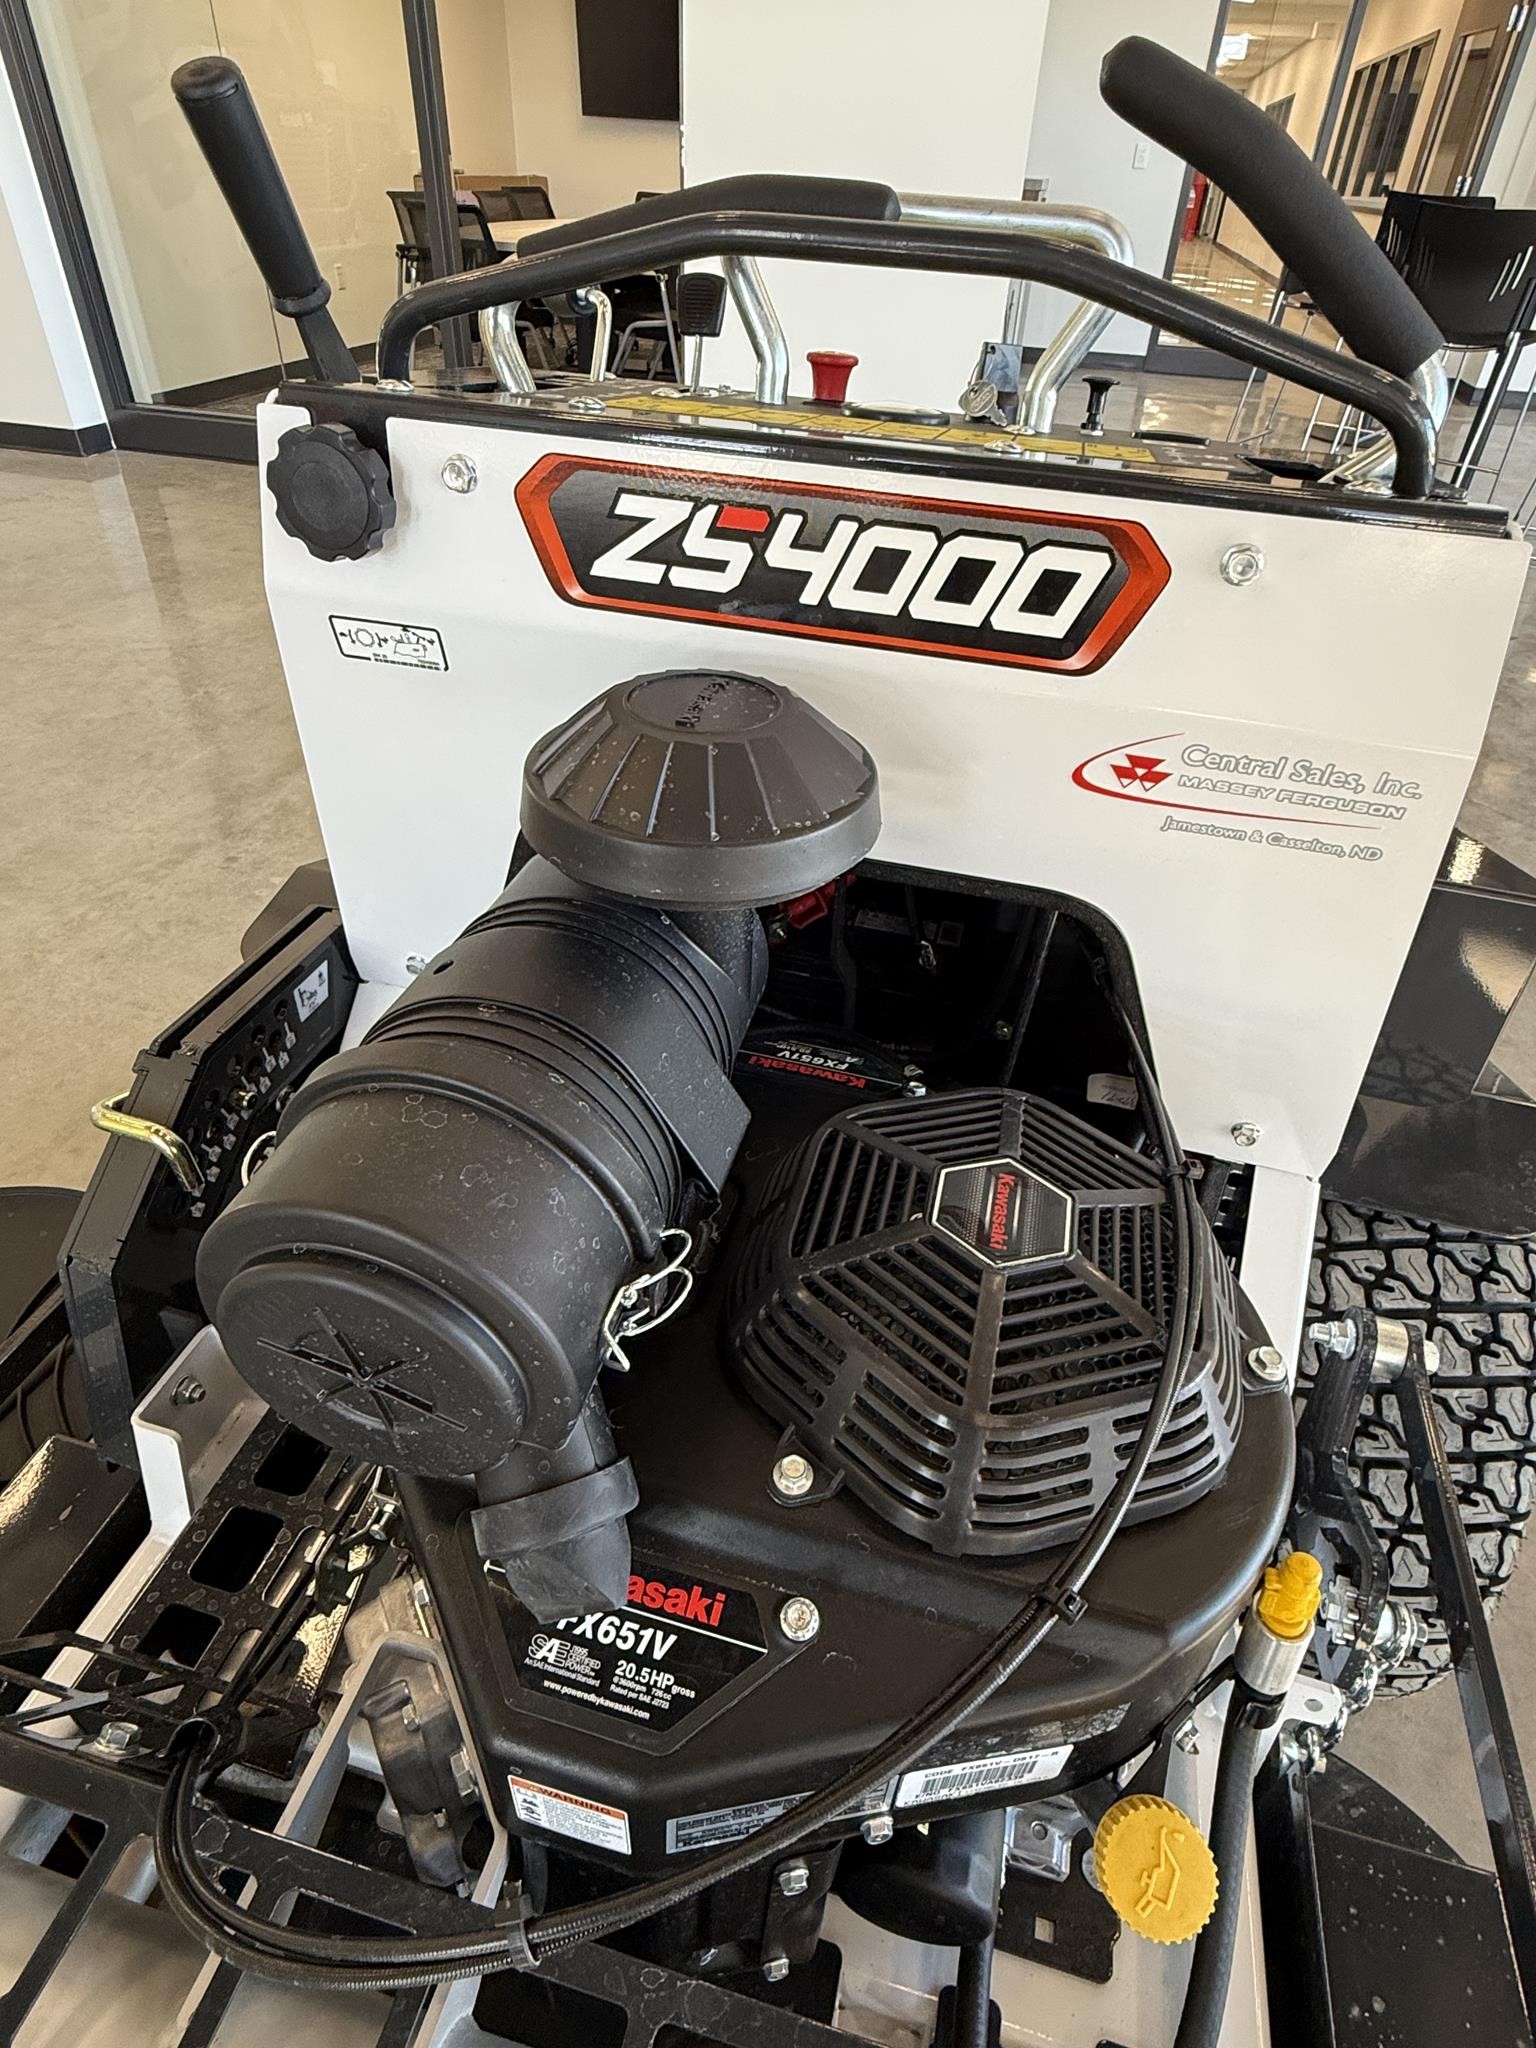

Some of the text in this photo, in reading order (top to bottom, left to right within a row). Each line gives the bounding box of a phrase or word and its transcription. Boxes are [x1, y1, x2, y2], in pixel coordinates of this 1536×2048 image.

[589, 493, 1112, 639] ZS4000
[1181, 744, 1423, 800] Central Sales, Inc.
[1178, 775, 1407, 820] MASSEY FERGUSON
[1160, 816, 1383, 862] Jamestown & Casselton, ND
[748, 1056, 866, 1089] Kawasaki
[777, 1051, 850, 1070] FX651V
[989, 1172, 1016, 1251] Kawasaki
[626, 1574, 726, 1627] asaki
[528, 1634, 571, 1667] SAE
[568, 1653, 601, 1670] CERTIFIED
[532, 1659, 545, 1669] SAE
[544, 1664, 577, 1679] International
[576, 1673, 600, 1687] Standard
[543, 1680, 650, 1720] www.poweredbykawasaki.com
[610, 1684, 628, 1696] Rated
[627, 1691, 638, 1700] per
[638, 1693, 652, 1703] SAE
[671, 1685, 696, 1699] gross
[925, 1769, 954, 1778] CODE
[541, 1788, 612, 1815] WARNING
